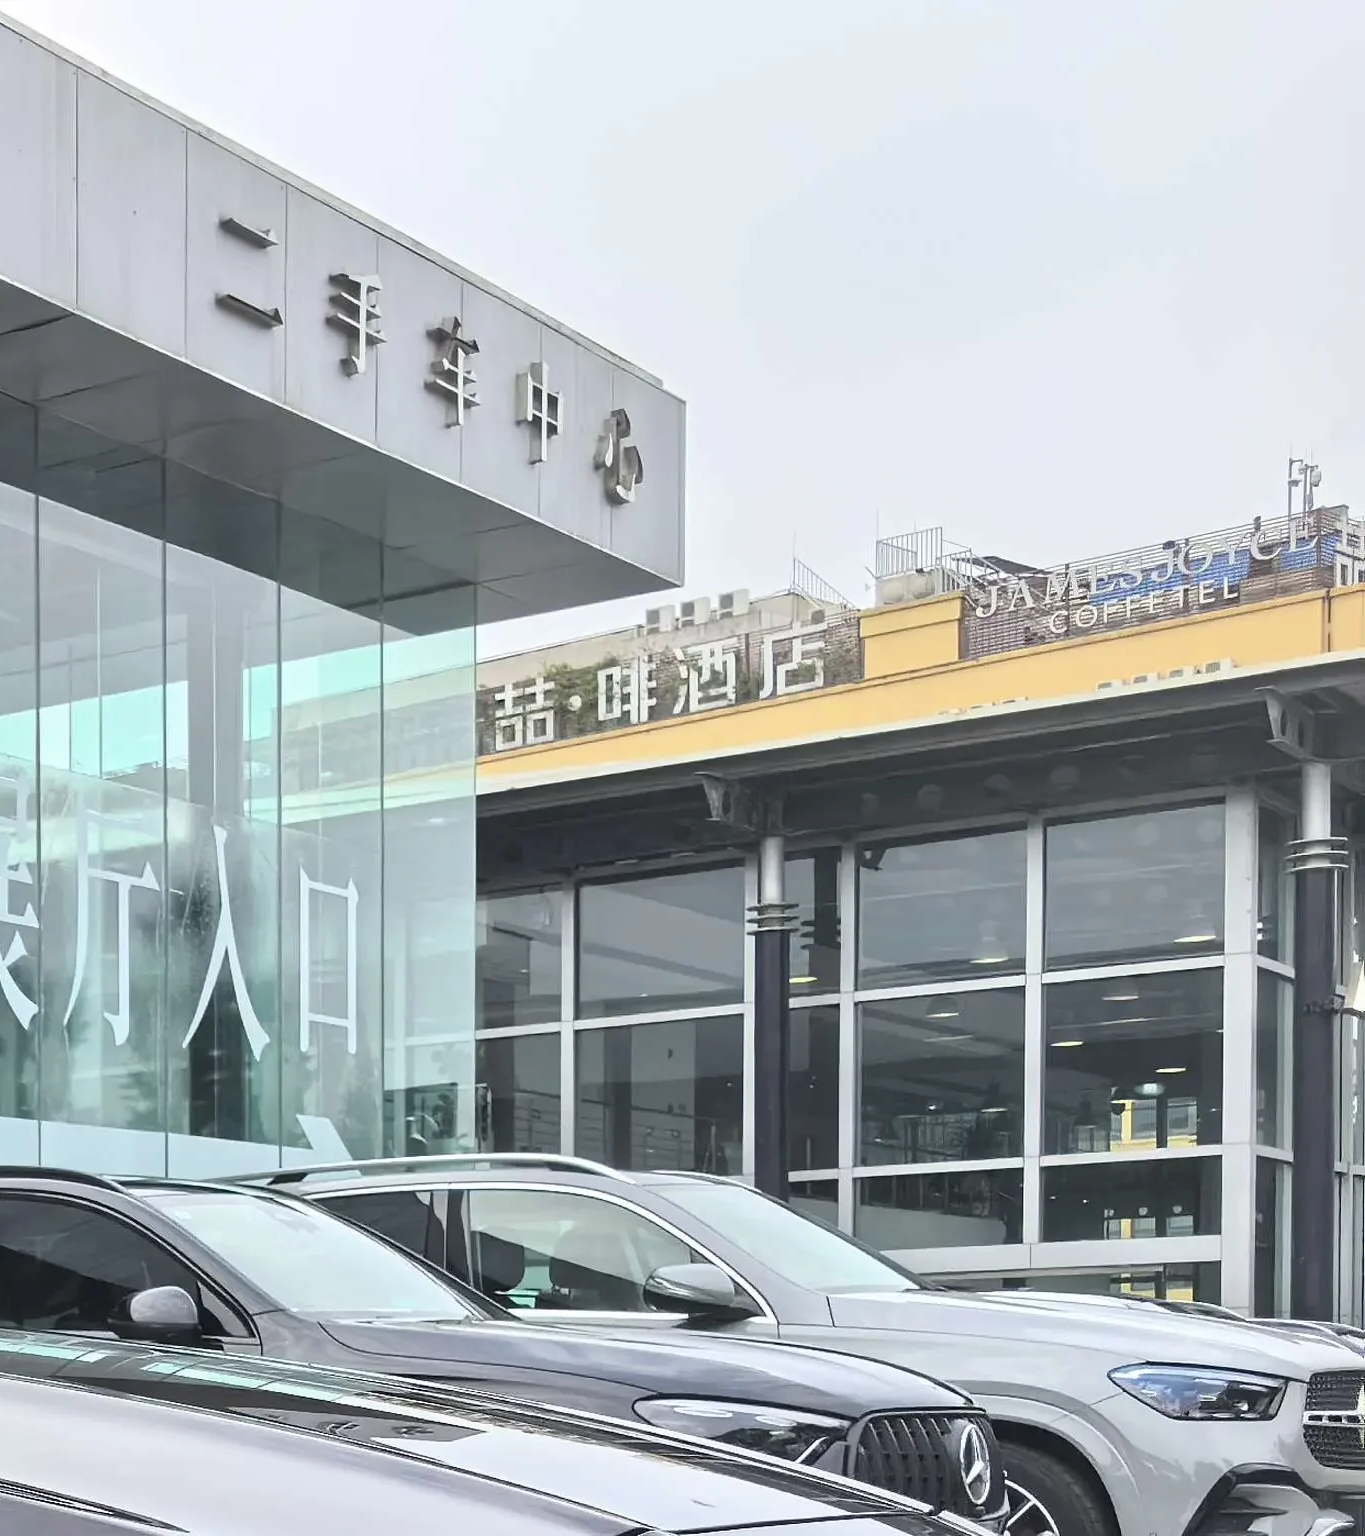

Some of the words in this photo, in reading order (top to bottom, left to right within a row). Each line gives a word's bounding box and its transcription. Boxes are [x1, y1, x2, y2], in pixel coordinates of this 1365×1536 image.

[216, 216, 644, 505] 二手车中心
